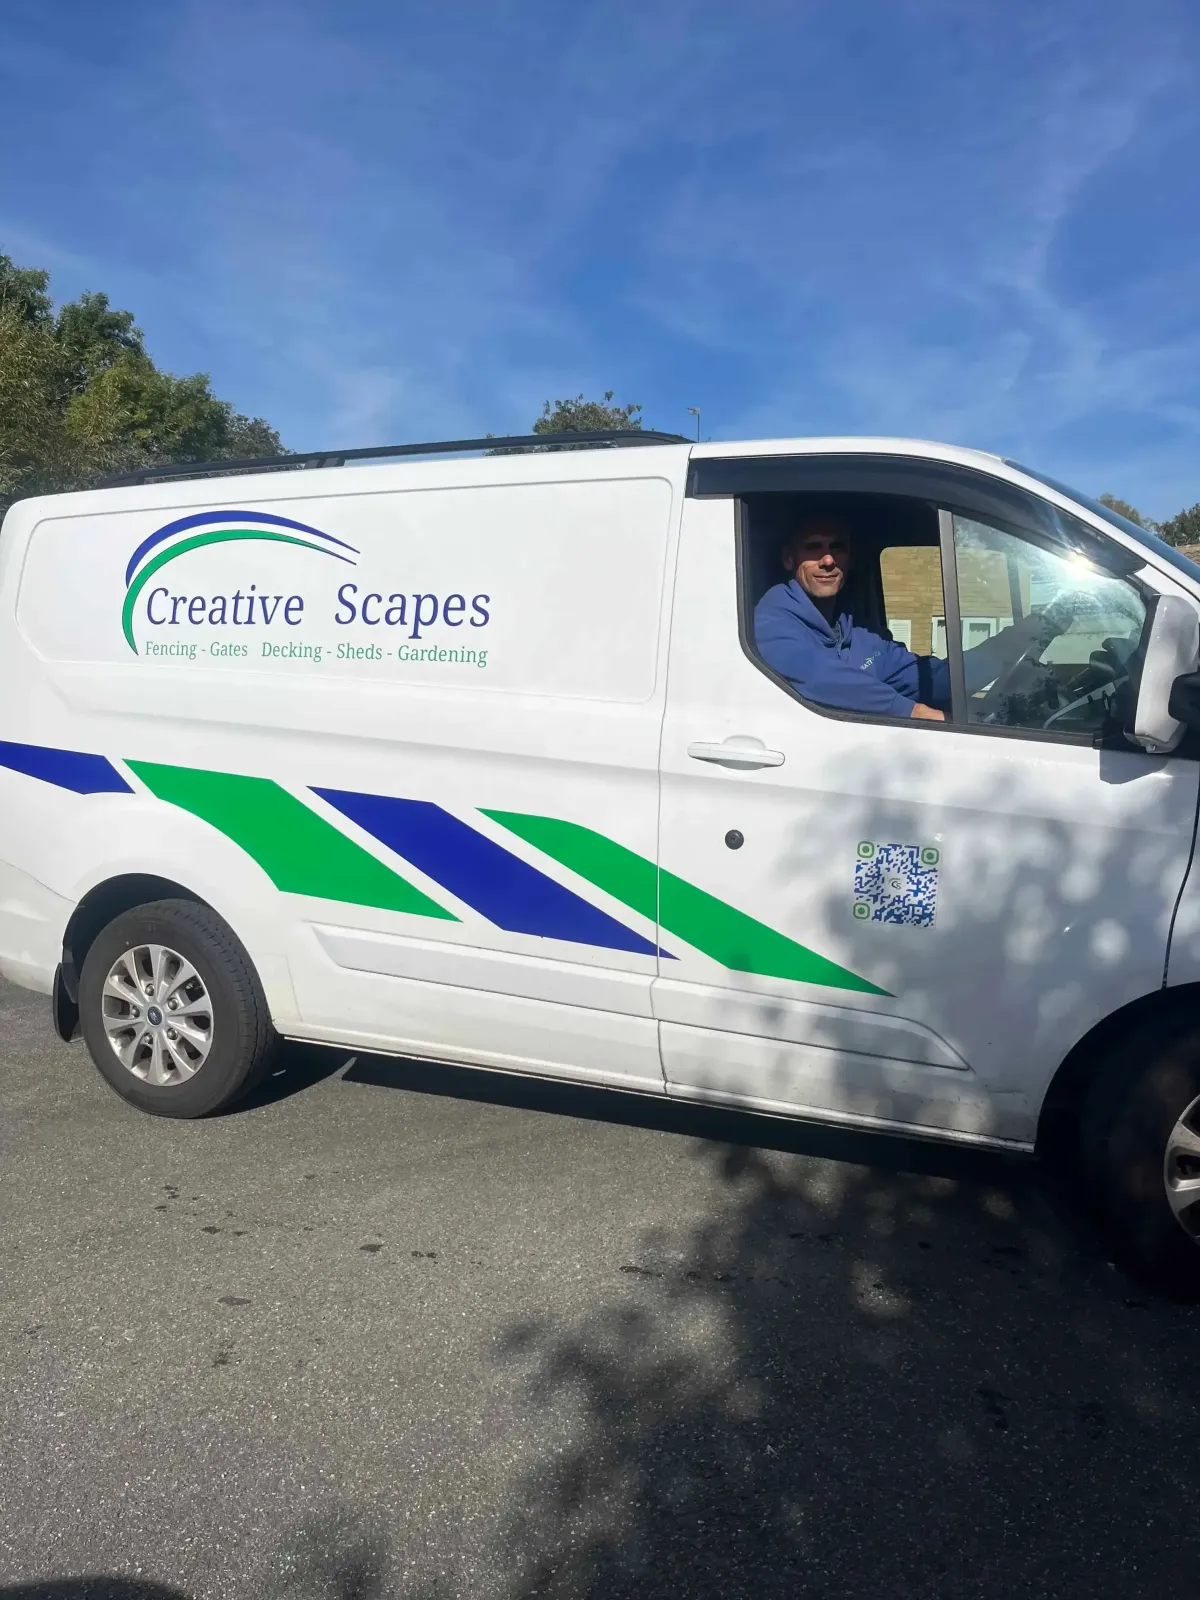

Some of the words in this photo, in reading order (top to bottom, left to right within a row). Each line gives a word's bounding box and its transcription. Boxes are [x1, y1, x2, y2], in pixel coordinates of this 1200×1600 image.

[147, 584, 304, 625] Creative
[334, 583, 491, 639] Scapes
[145, 641, 197, 660] Fencing
[210, 641, 248, 657] Gates
[261, 642, 323, 663] Decking
[336, 643, 383, 660] Sheds
[398, 645, 488, 668] Gardening
